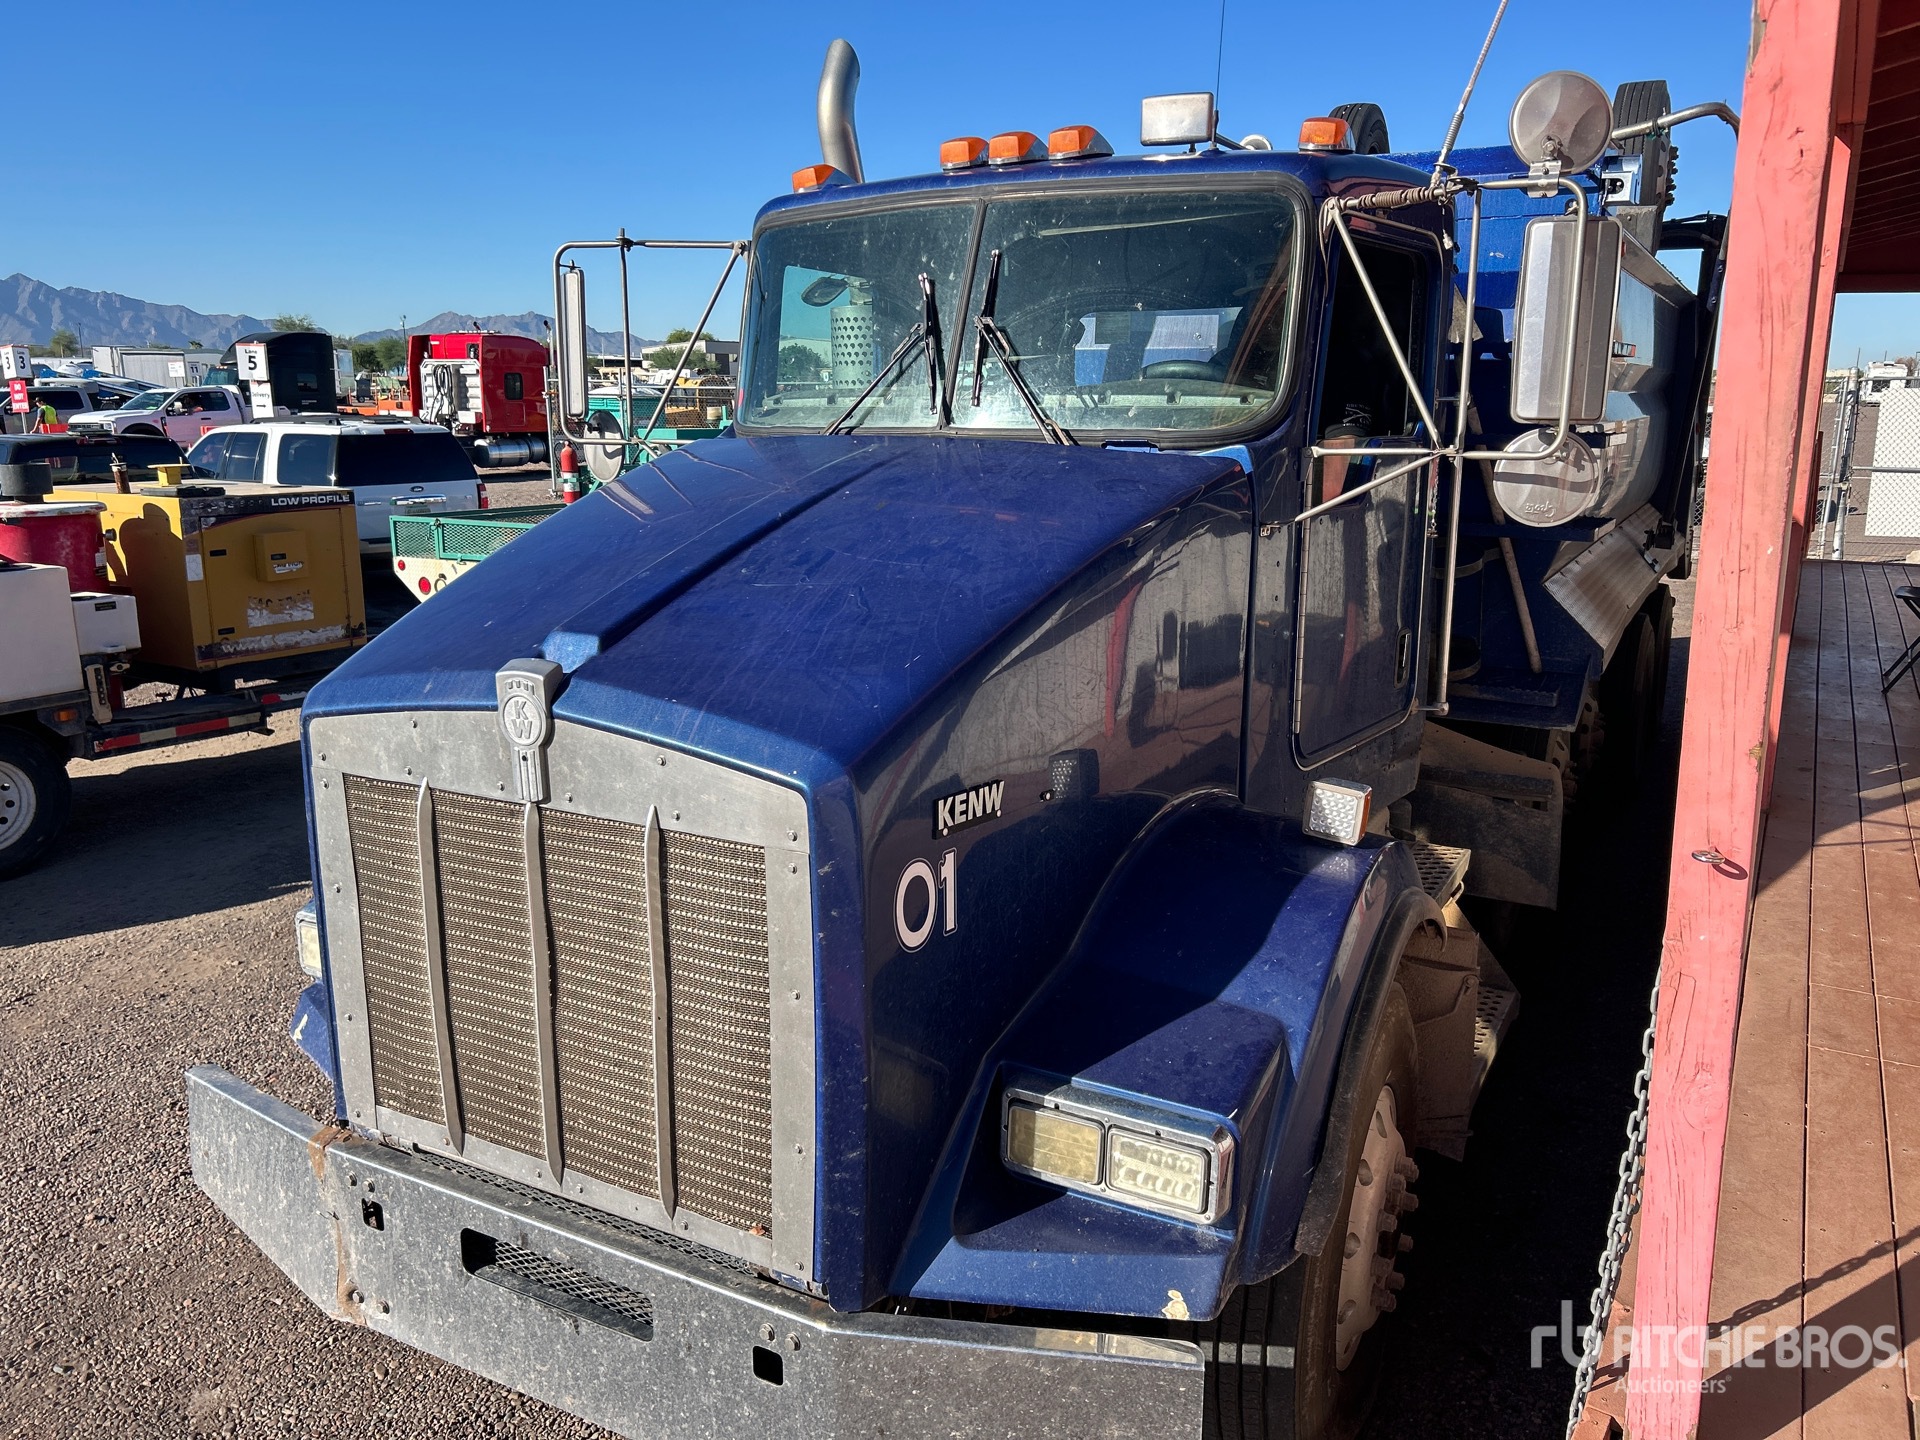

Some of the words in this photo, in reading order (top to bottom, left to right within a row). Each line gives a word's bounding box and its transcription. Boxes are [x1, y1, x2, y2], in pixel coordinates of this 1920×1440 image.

[5, 356, 10, 370] 3
[19, 356, 25, 369] 3
[248, 355, 257, 370] 5
[271, 498, 300, 507] LOW
[302, 495, 350, 504] PROFILE
[938, 780, 1005, 830] KENW
[893, 847, 958, 953] 01
